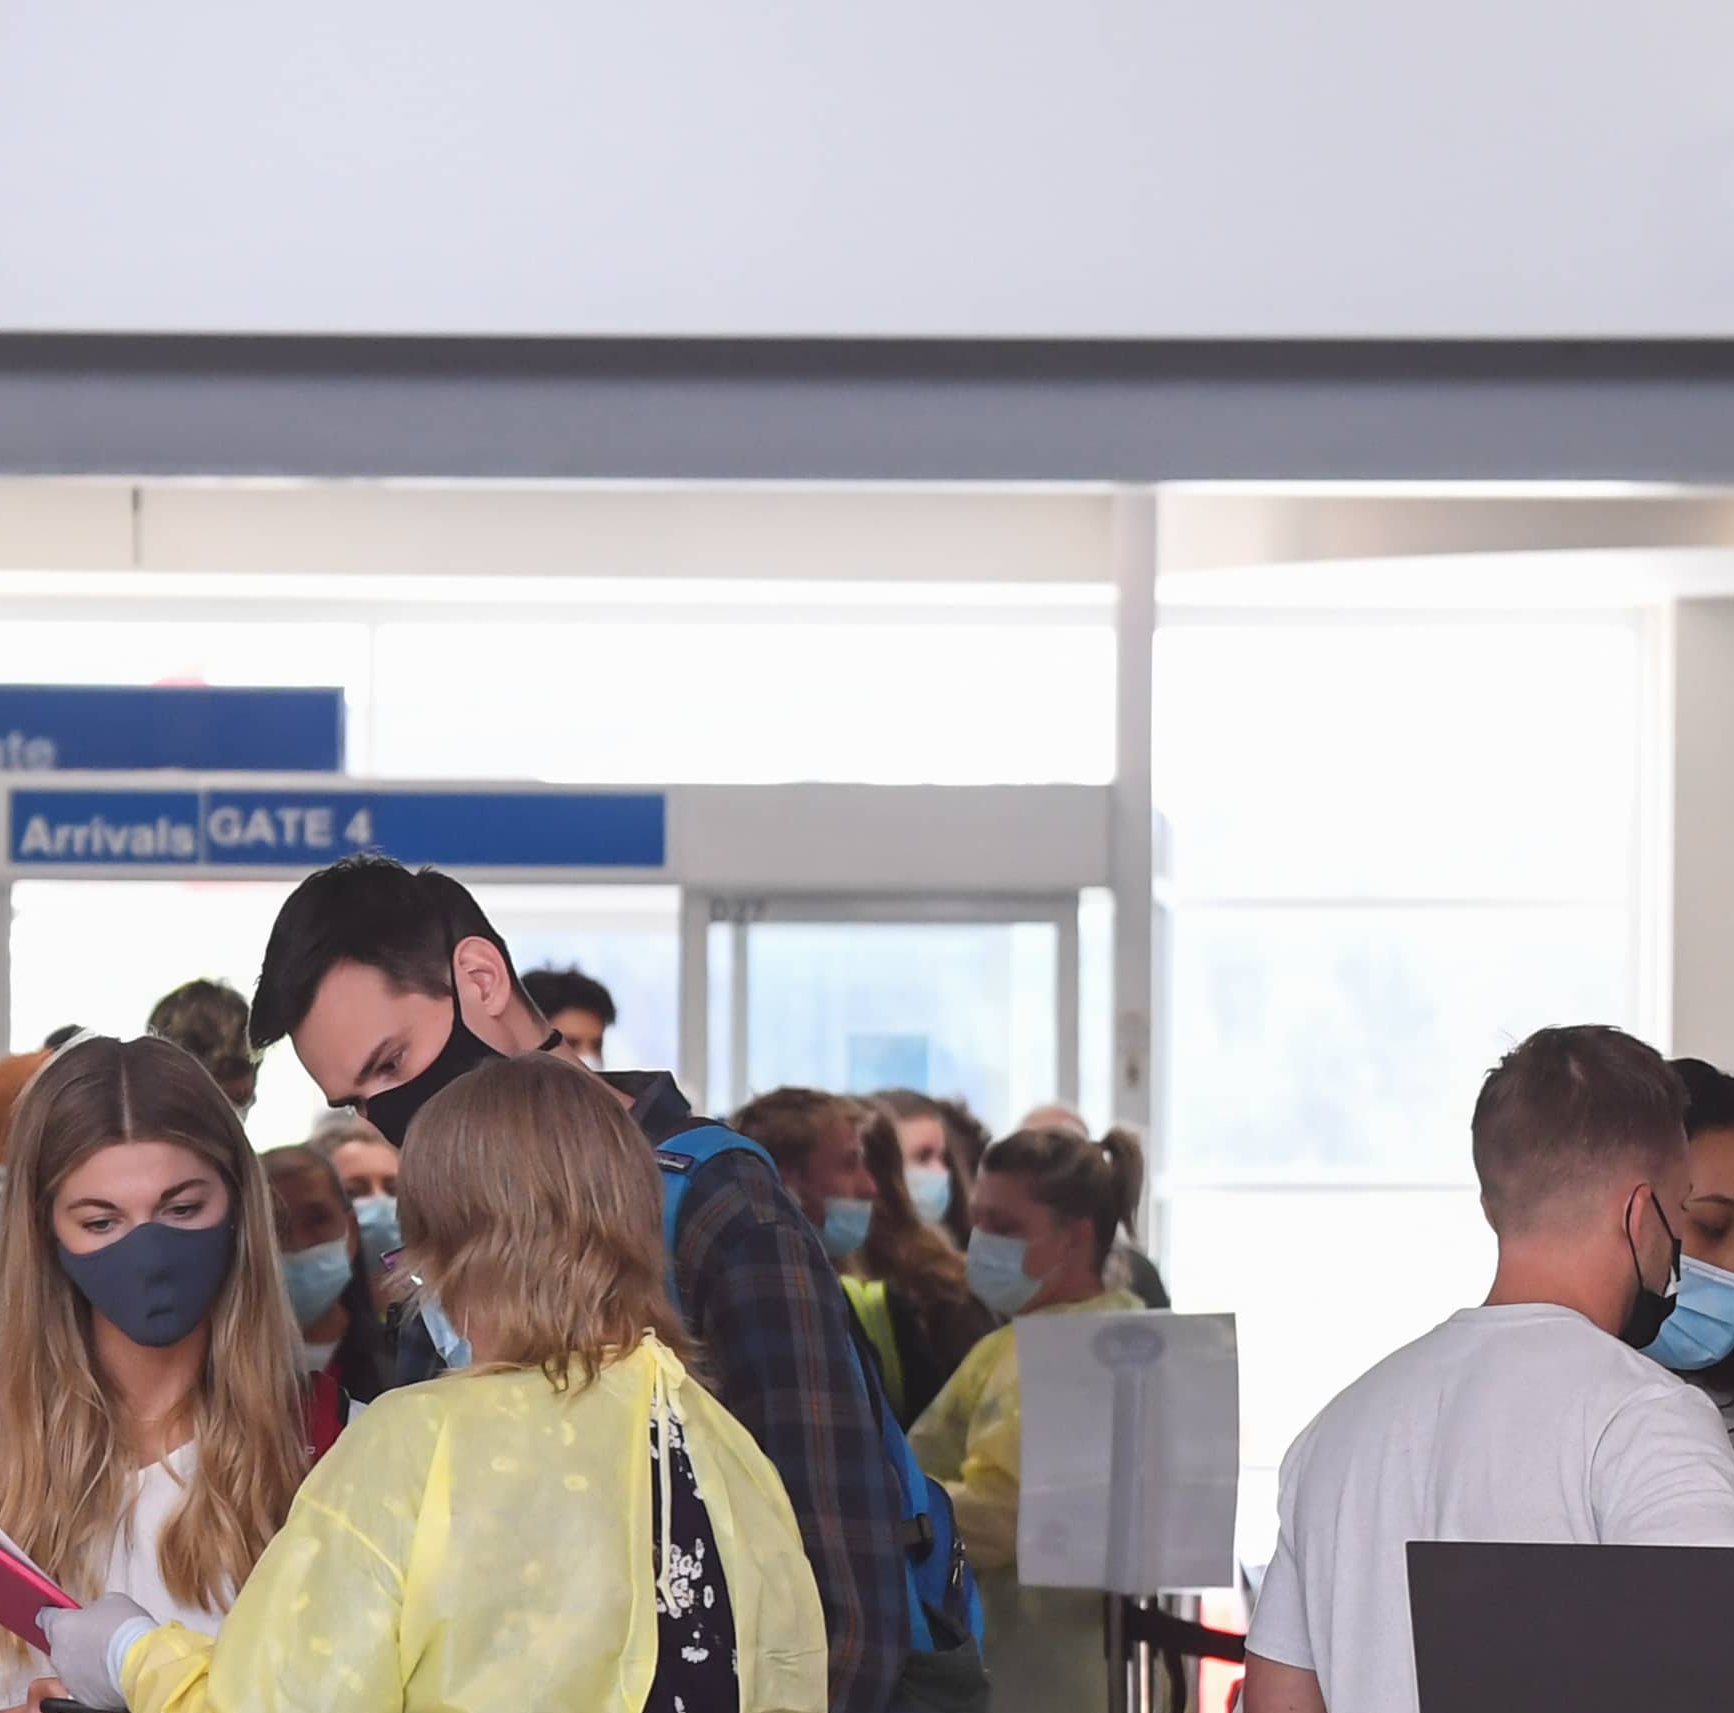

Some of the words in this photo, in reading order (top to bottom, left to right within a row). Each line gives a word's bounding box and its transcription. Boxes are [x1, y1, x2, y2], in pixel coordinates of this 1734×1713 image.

[20, 812, 194, 857] Arrivals
[208, 807, 332, 849] GATE
[344, 807, 373, 848] 4
